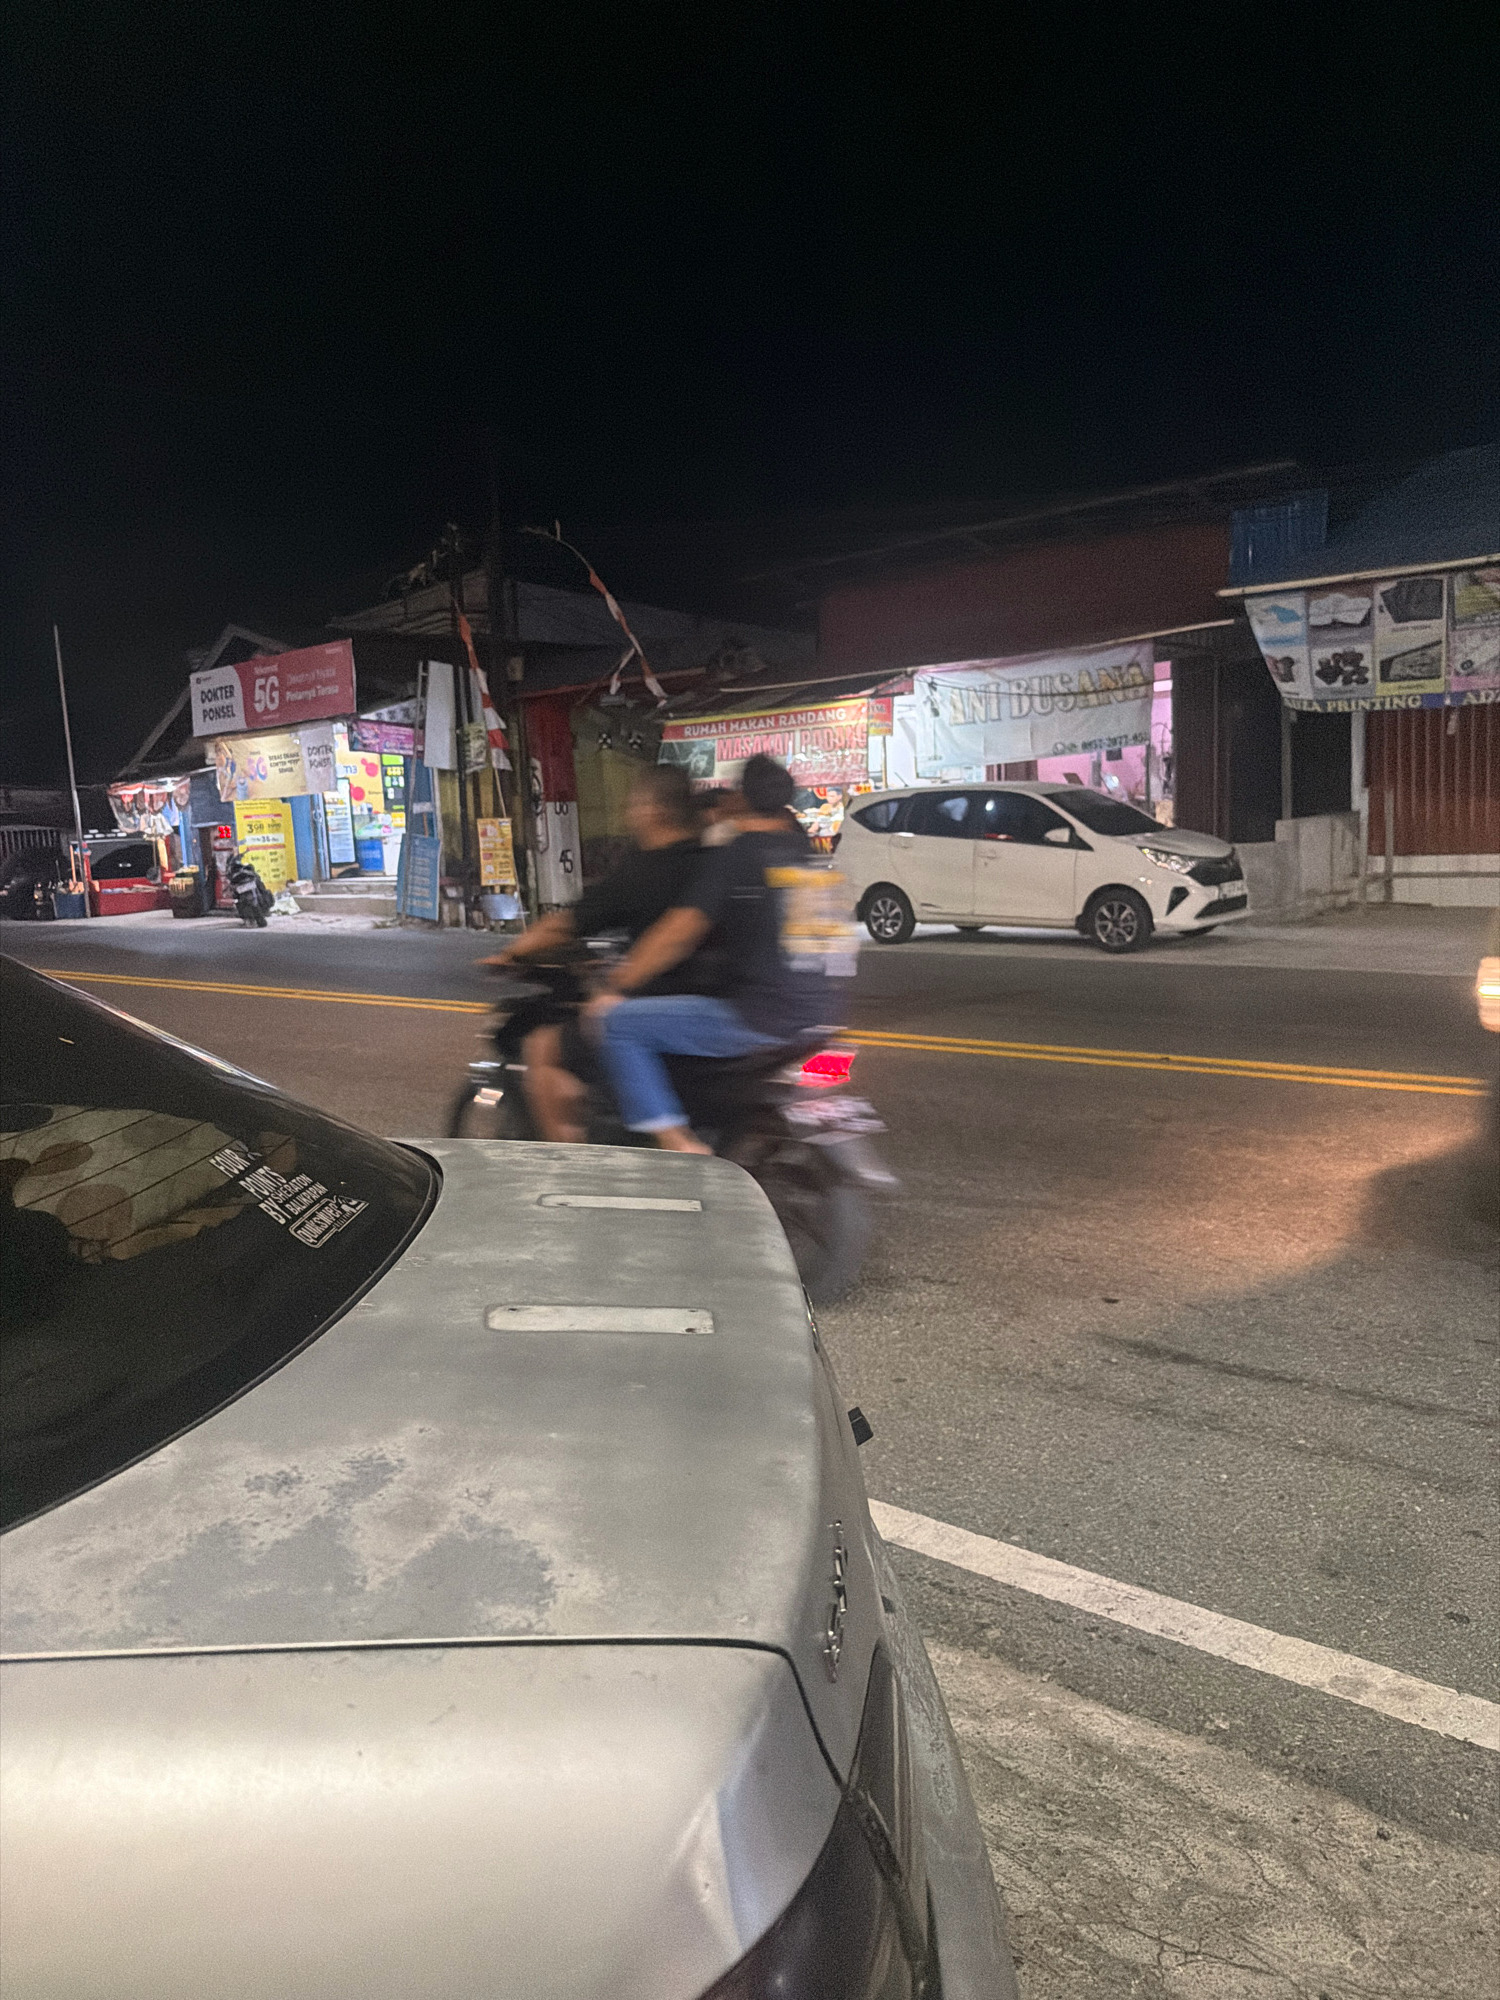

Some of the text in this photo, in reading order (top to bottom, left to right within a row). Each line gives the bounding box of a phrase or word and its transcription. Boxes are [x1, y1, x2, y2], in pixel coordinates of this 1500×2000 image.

[200, 685, 235, 704] DOKTER
[254, 676, 279, 712] 5G
[1008, 662, 1148, 720] BUSANA
[1326, 696, 1421, 712] PRINTING
[202, 704, 236, 722] PONSEL
[684, 721, 726, 737] RUMAH
[730, 716, 775, 734] MAKAN
[779, 707, 847, 729] RANDANG
[717, 721, 868, 762] MASAKAN PADANG
[559, 849, 573, 873] 45
[208, 1148, 250, 1178] FOUR
[239, 1165, 287, 1200] POINTS
[258, 1173, 313, 1225] BY SHERATON
[285, 1182, 328, 1215] BALIKPAPAN
